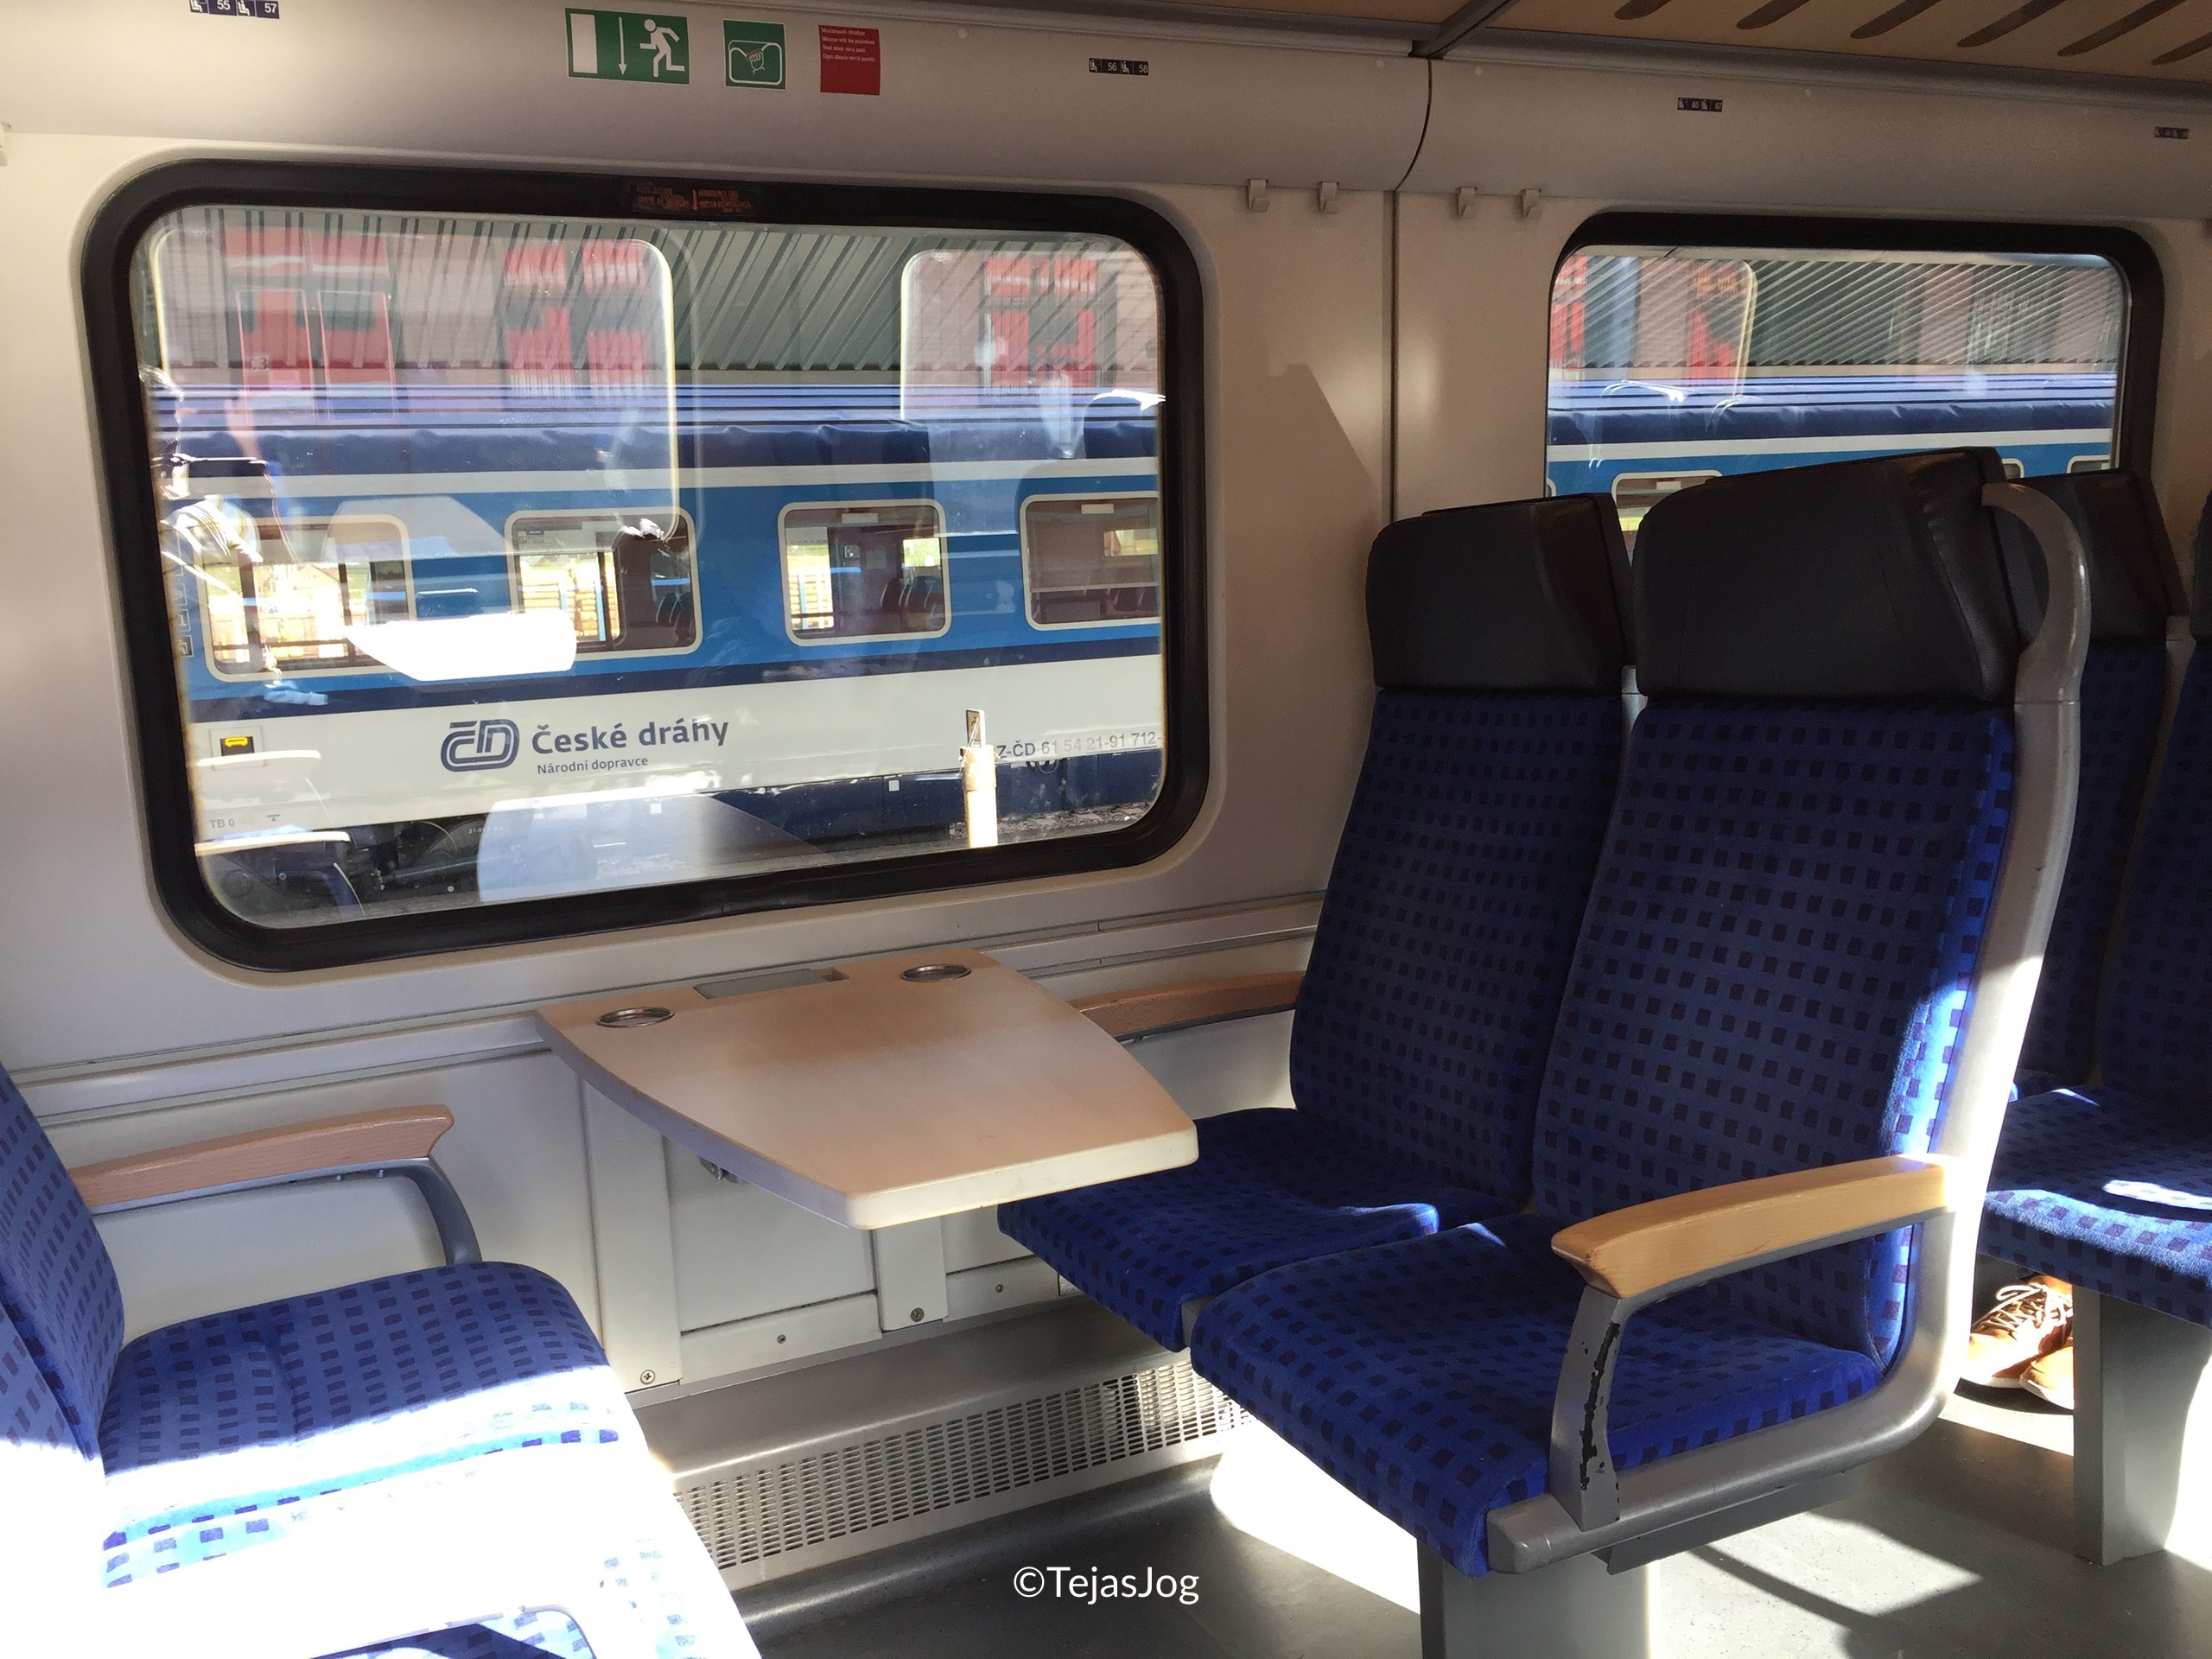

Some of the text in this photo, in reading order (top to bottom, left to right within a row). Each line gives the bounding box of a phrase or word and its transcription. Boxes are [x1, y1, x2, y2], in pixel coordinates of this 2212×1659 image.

[217, 0, 277, 14] 55 57
[1108, 62, 1148, 73] 56 58
[532, 717, 729, 754] České dráhy
[996, 731, 1163, 759] Z-ČD 61 54 21-91 712-
[537, 756, 649, 774] Národní dopravce
[209, 818, 226, 829] TB
